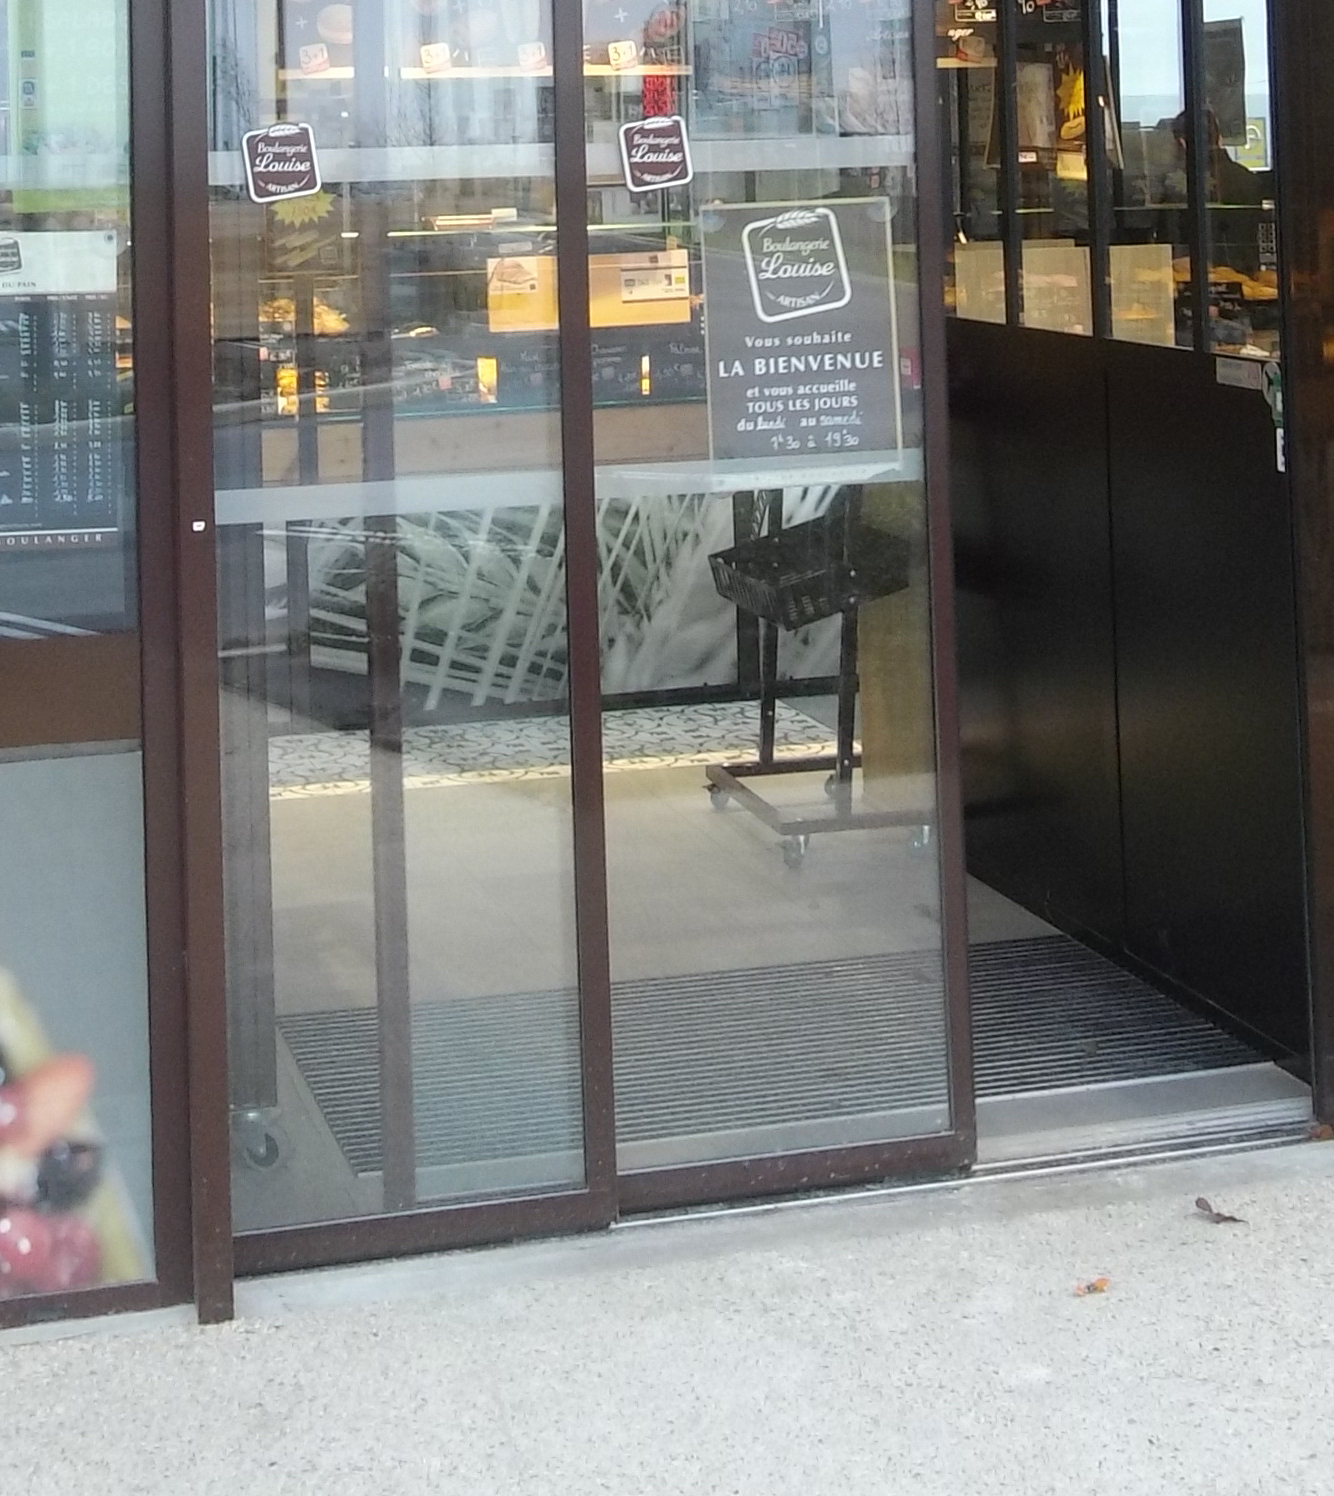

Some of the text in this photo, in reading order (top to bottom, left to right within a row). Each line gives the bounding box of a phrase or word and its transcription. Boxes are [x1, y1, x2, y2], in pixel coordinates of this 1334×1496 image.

[253, 152, 311, 173] Louise
[630, 144, 684, 163] Louise
[763, 238, 830, 256] Boulangerie
[758, 253, 835, 280] Louise
[745, 331, 852, 348] Vous souhaite
[719, 351, 884, 378] LA BIENVENUE
[746, 379, 856, 398] et vous accueille
[747, 395, 858, 414] TOUS LES JOURS
[737, 416, 754, 431] du
[800, 415, 816, 427] au
